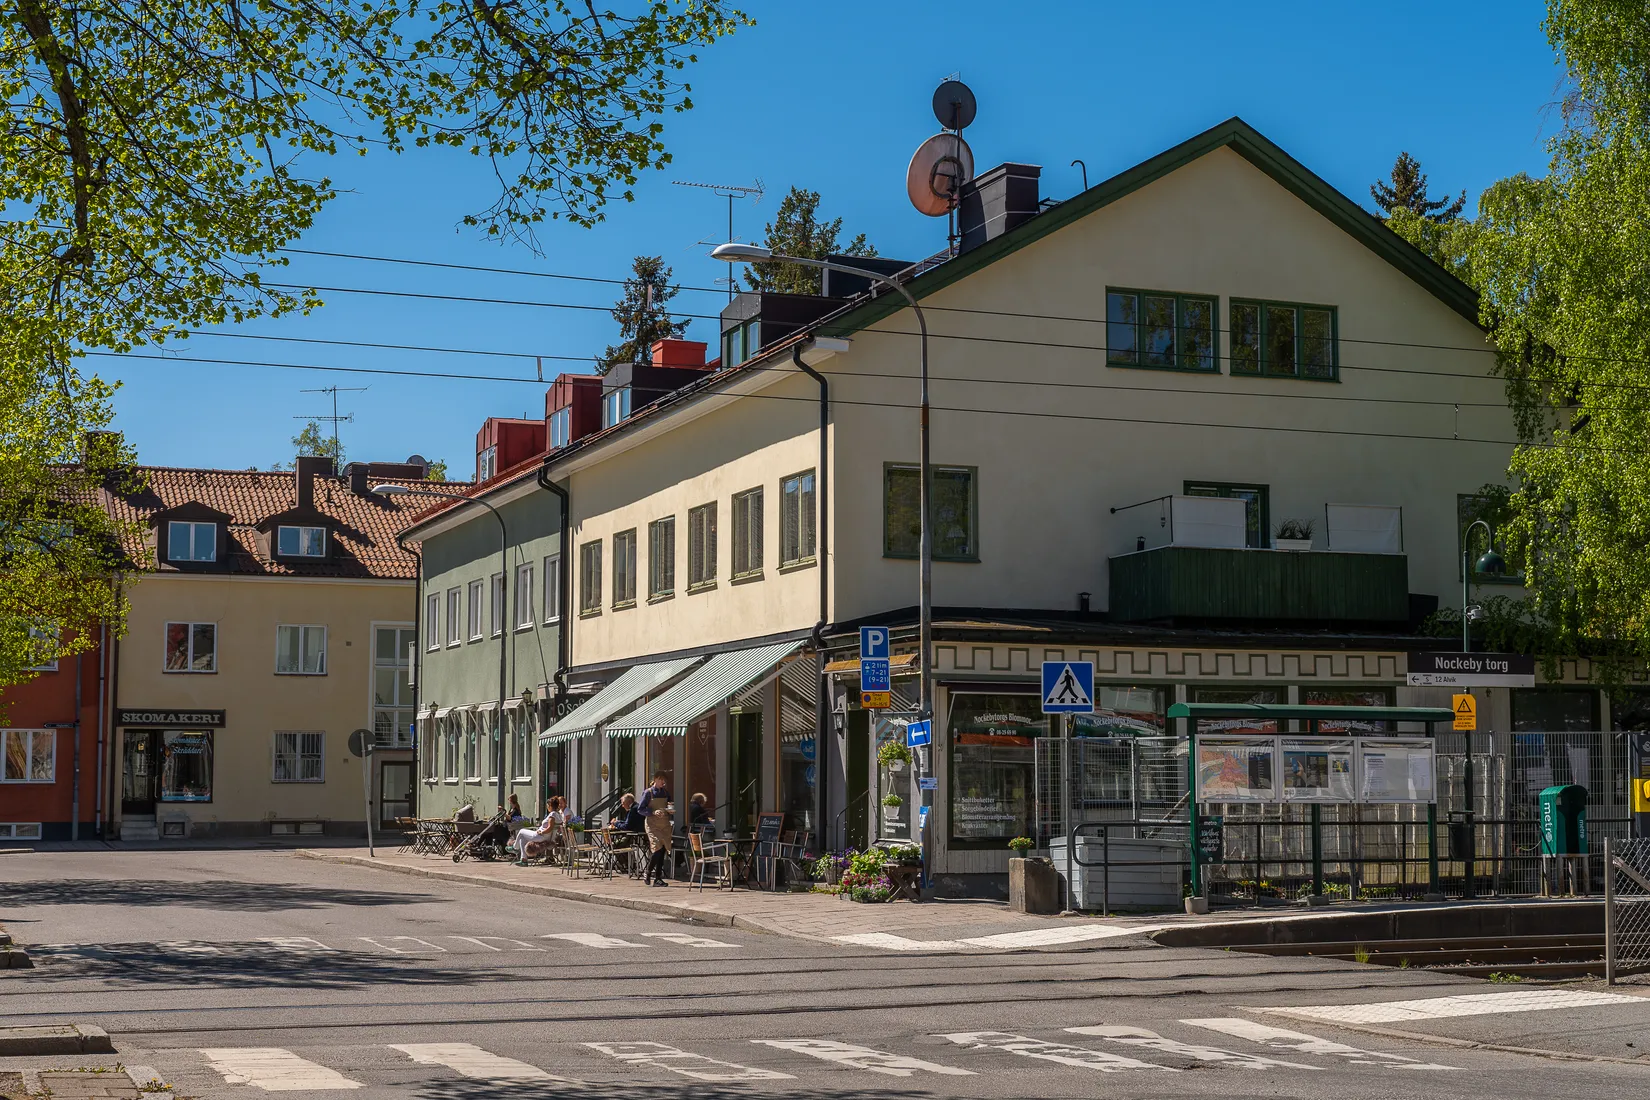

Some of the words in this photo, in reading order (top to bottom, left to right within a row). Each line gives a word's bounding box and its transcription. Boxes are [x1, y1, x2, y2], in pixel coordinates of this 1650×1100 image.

[868, 630, 884, 656] P
[1435, 657, 1482, 672] Nockeby
[1486, 658, 1509, 673] torg
[122, 712, 220, 724] SKOMAKERI
[974, 713, 1008, 724] Nockebytorgs
[1008, 713, 1032, 724] Blommor
[1544, 802, 1553, 843] metro
